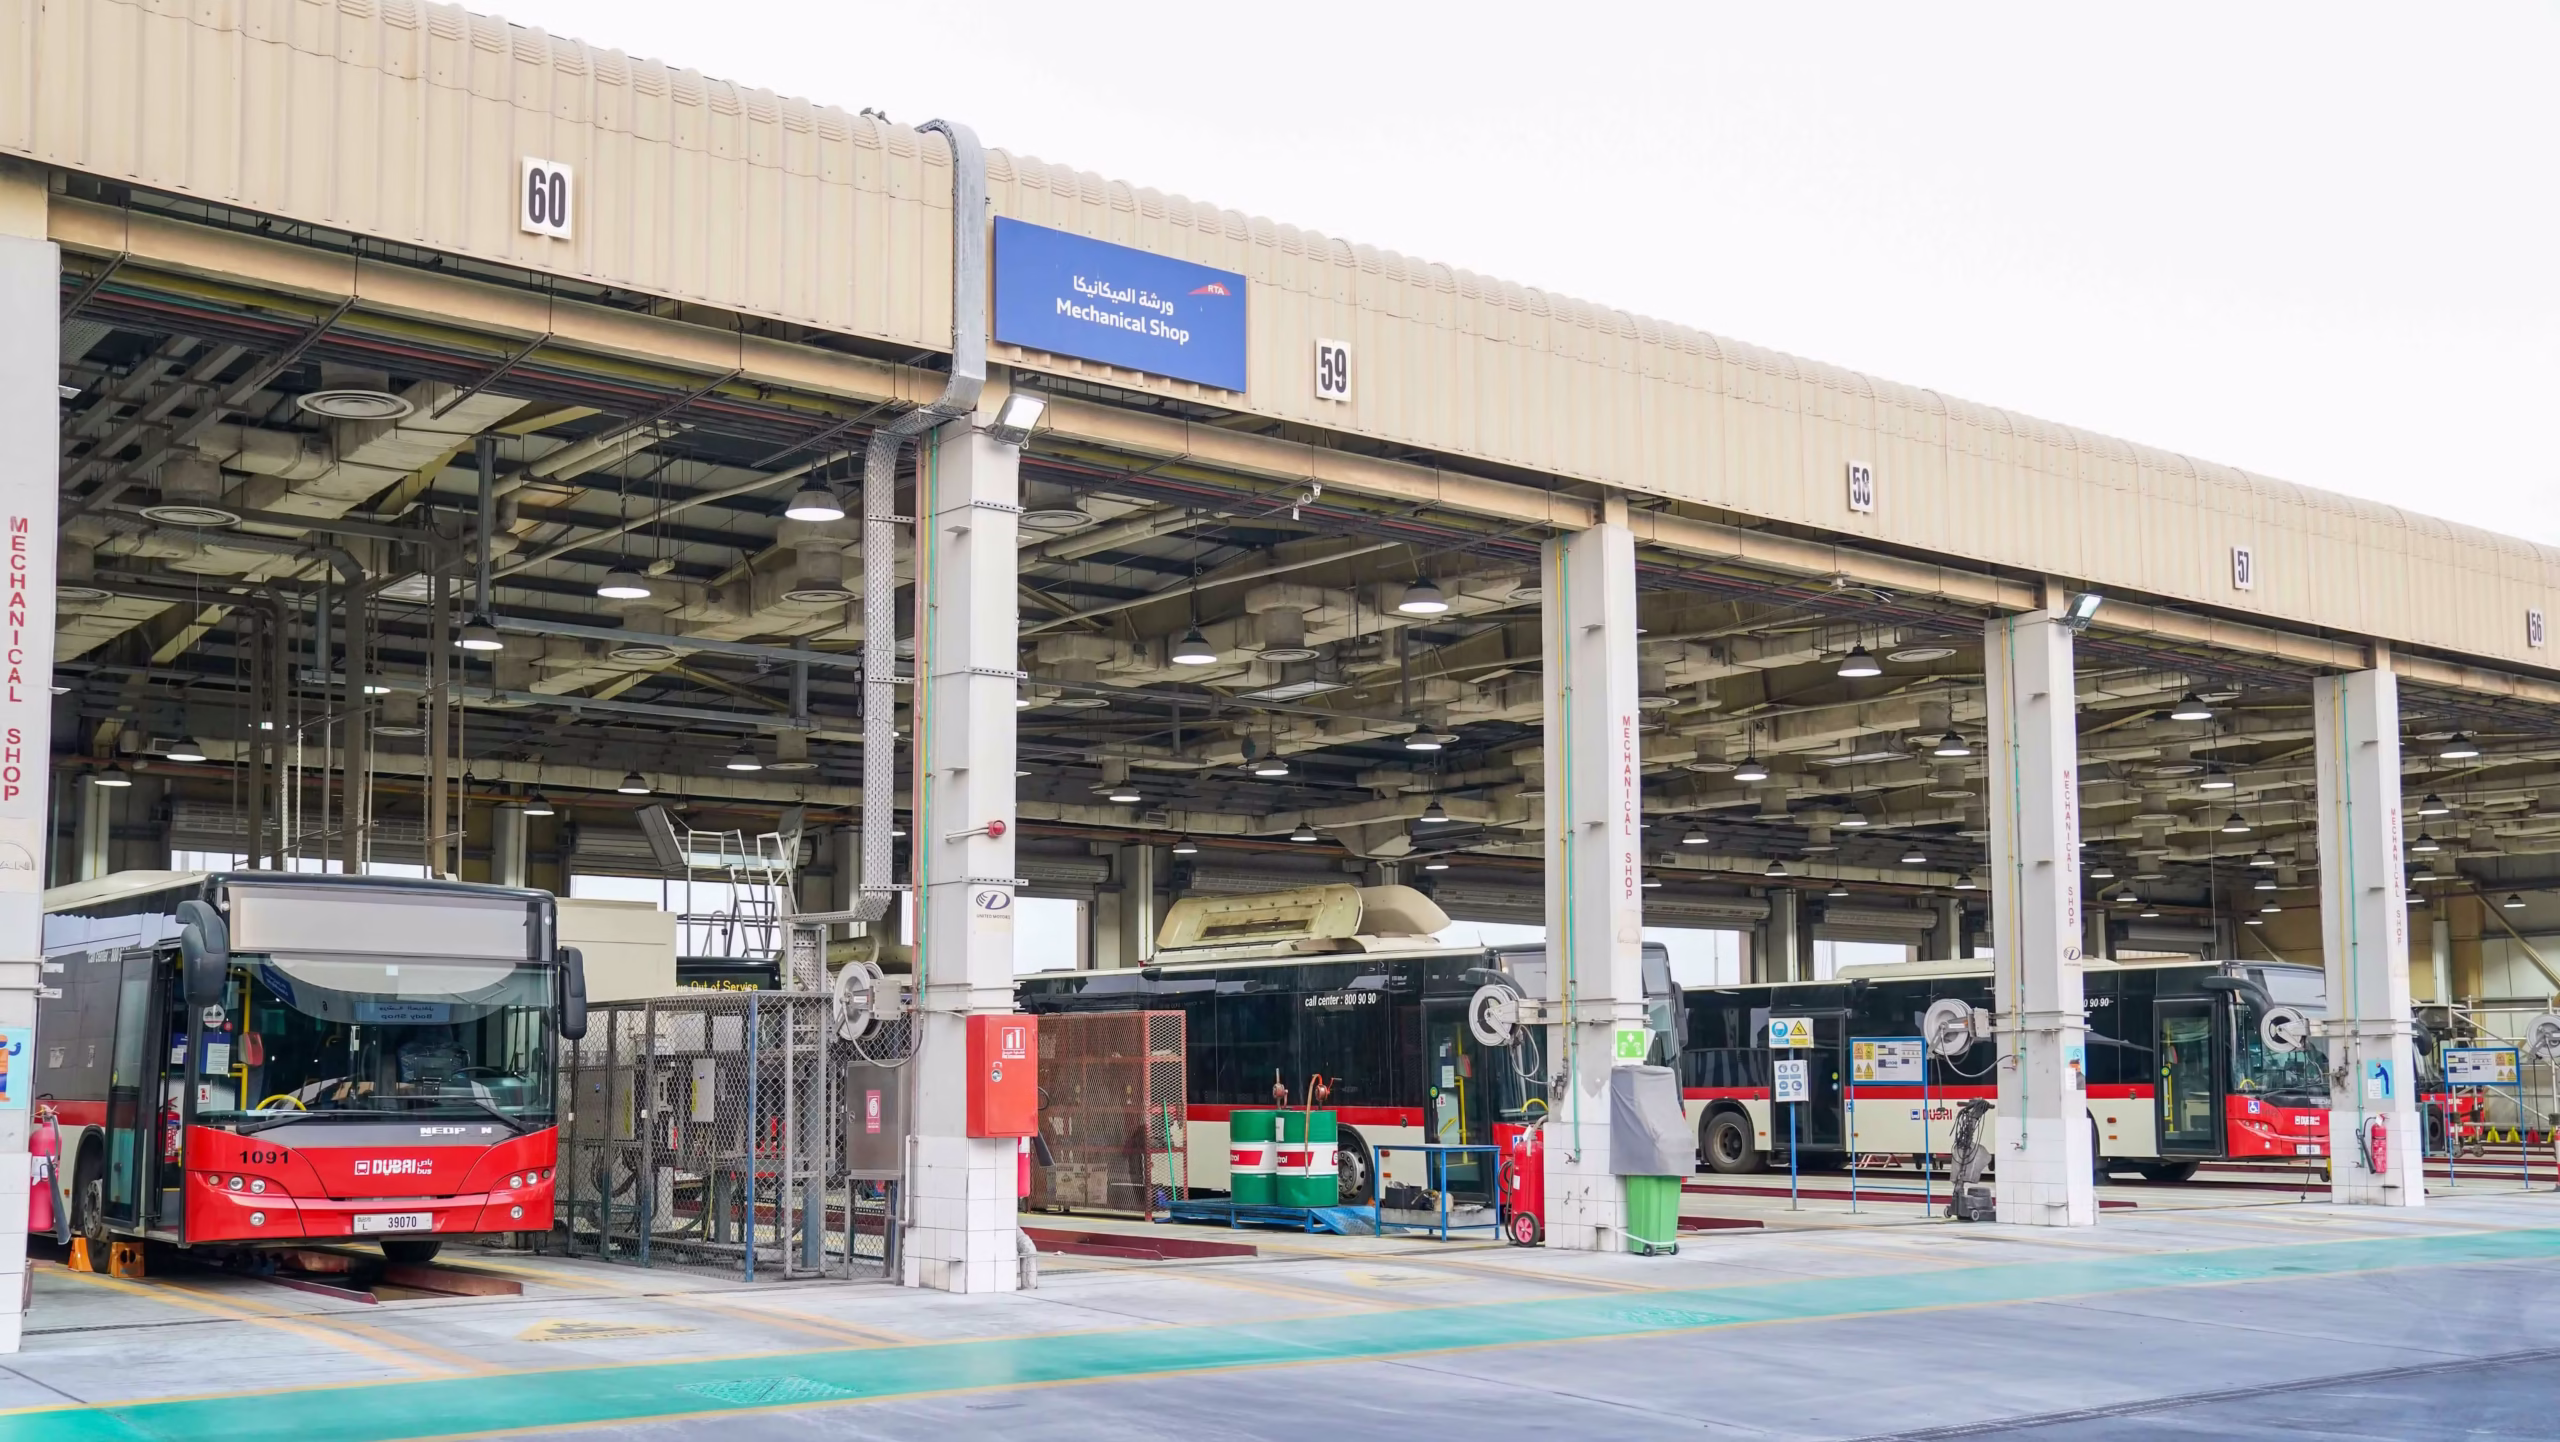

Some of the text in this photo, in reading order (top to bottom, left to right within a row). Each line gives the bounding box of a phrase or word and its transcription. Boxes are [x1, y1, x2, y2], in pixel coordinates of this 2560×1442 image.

[528, 167, 566, 228] 60
[1073, 275, 1174, 316] ورشة الميكانيكا
[1207, 284, 1225, 296] RTA
[1056, 297, 1190, 346] Mechanical Shop
[1320, 346, 1347, 394] 59
[1852, 466, 1871, 506] 58
[2237, 550, 2249, 584] 57
[2531, 612, 2542, 643] 56
[2, 516, 28, 801] MECHANICAL SHOP
[1622, 715, 1632, 836] MECHANICAL
[2063, 769, 2075, 928] MECHANICAL SHOP
[2391, 808, 2400, 898] MECHANICAL
[691, 980, 708, 993] Out
[711, 980, 721, 992] of
[723, 980, 758, 992] Service
[1304, 995, 1318, 1007] call
[1318, 994, 1340, 1006] center
[1344, 993, 1357, 1006] 800
[1357, 992, 1367, 1005] 90
[1367, 992, 1377, 1005] 90
[2100, 997, 2109, 1007] 90
[420, 1126, 492, 1137] NEOPN
[239, 1150, 289, 1164] 1091
[372, 1159, 417, 1176] DUBAI
[416, 1167, 432, 1175] bus
[388, 1216, 417, 1228] 39070
